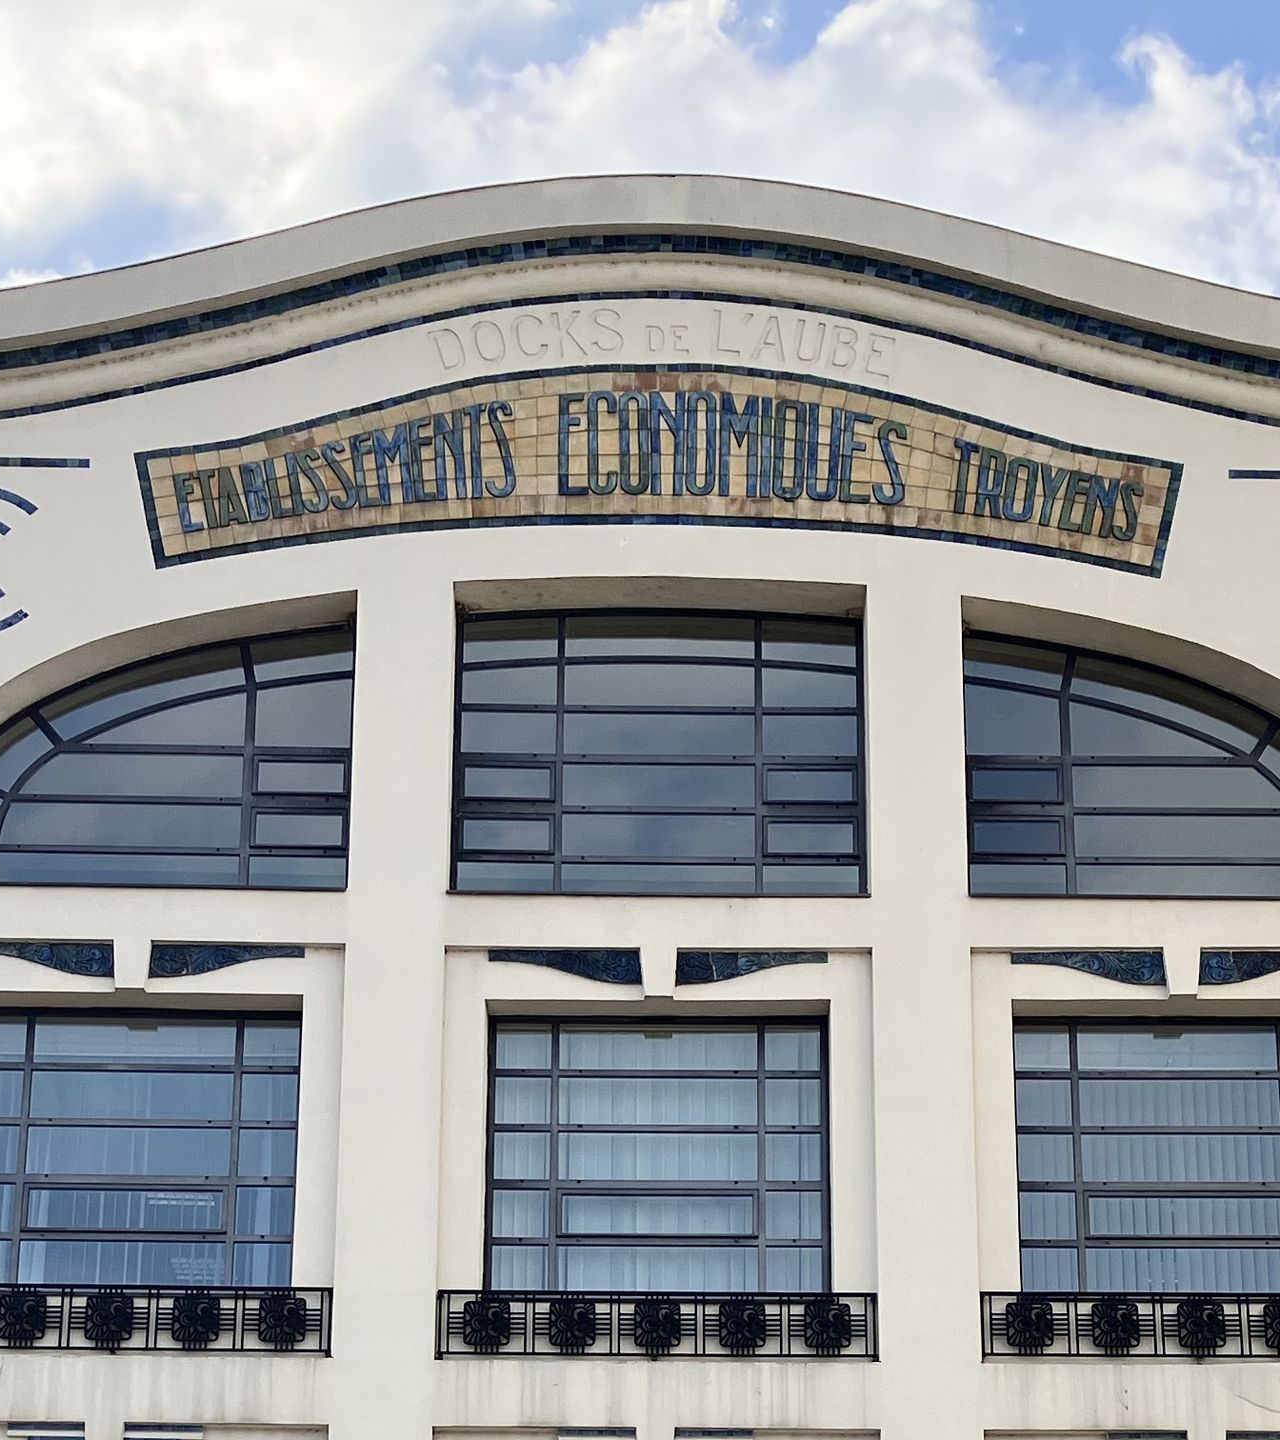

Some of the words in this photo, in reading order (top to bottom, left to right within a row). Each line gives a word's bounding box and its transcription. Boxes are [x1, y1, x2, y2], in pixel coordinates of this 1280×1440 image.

[427, 308, 625, 371] DOCKS
[645, 324, 691, 354] DE
[712, 309, 897, 380] L'AUBE
[173, 400, 516, 534] ETABLISSEMENTS
[558, 390, 908, 507] ECONOMIQUES
[954, 437, 1145, 542] TROYENS
